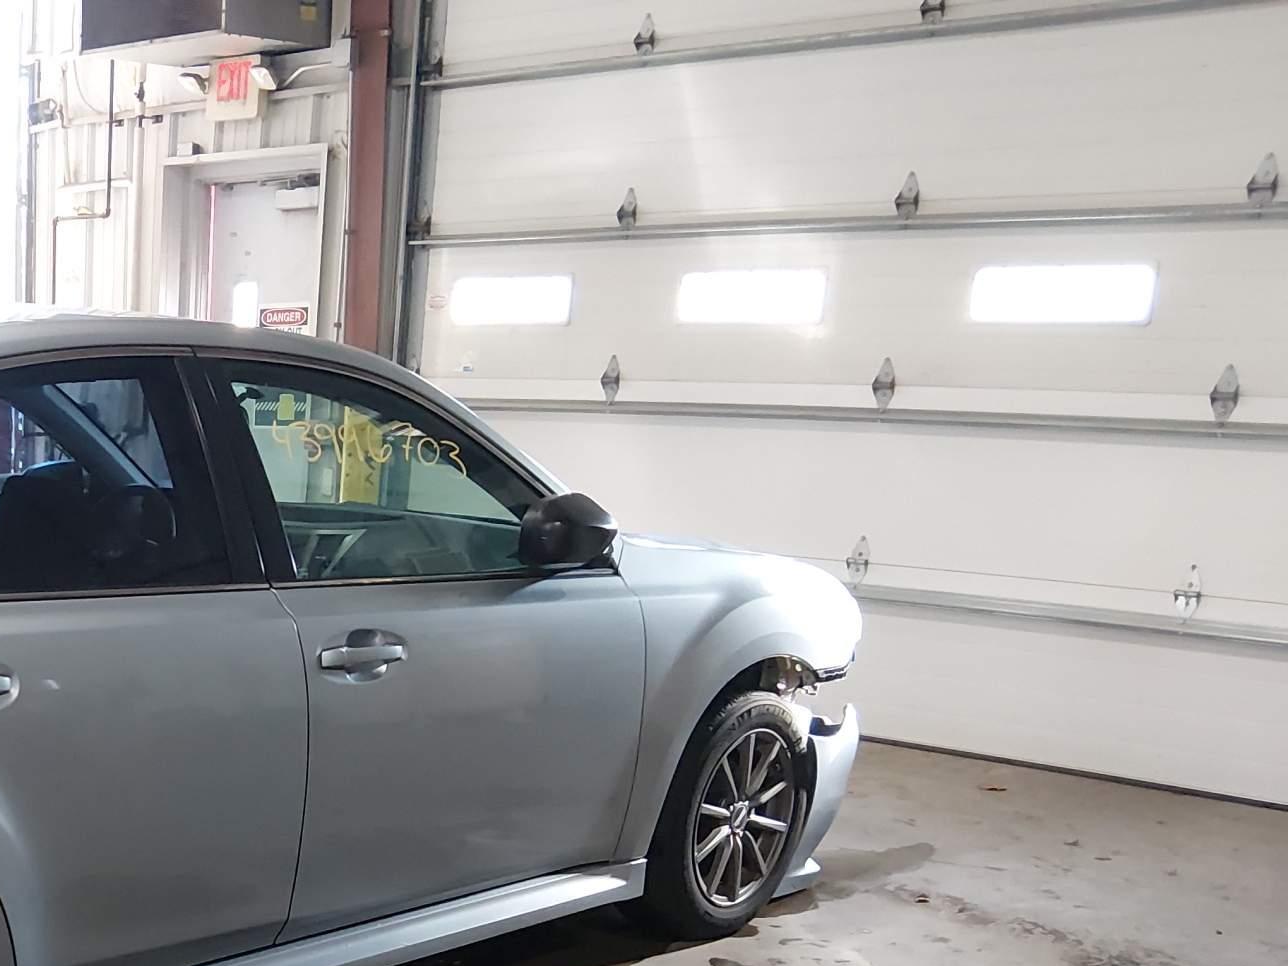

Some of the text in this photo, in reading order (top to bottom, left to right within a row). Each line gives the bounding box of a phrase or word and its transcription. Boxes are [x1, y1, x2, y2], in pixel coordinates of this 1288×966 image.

[215, 61, 253, 102] EXIT
[266, 311, 302, 323] DANGER
[272, 420, 468, 480] 43996703
